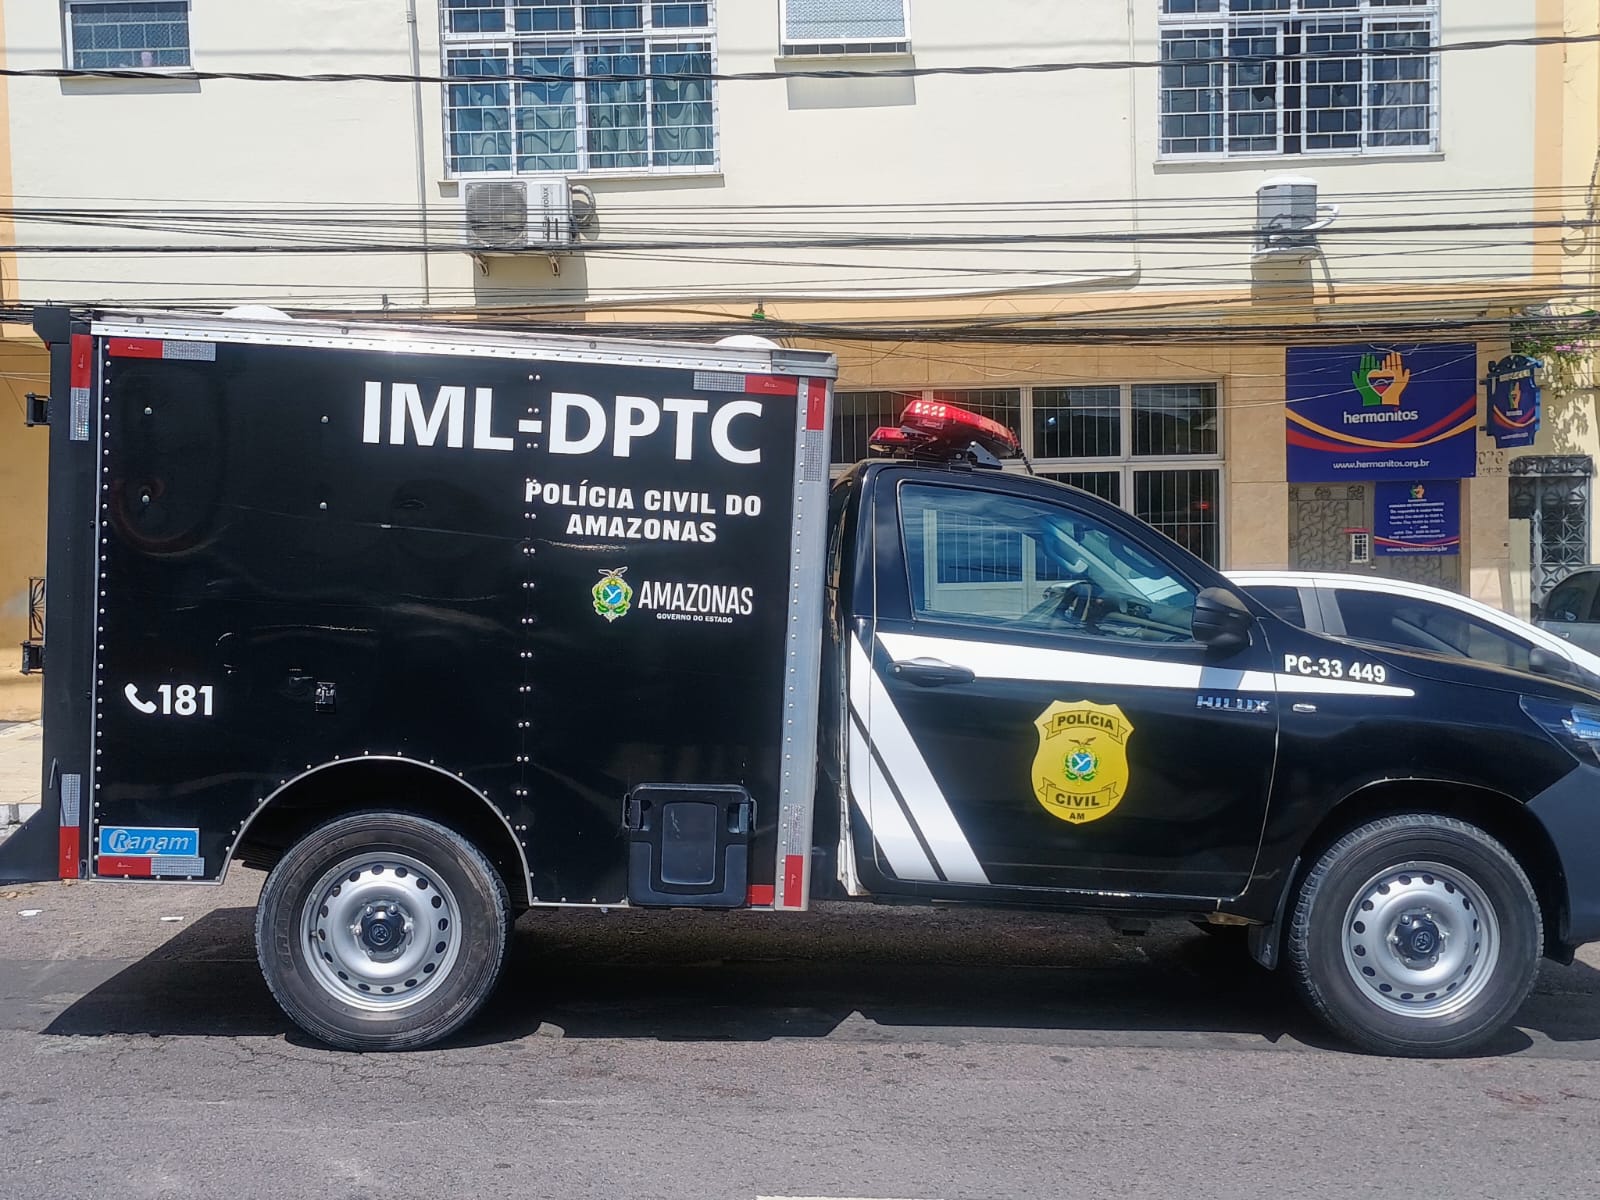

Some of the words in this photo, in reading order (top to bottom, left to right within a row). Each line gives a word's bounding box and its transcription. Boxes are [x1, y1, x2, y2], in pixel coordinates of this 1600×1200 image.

[363, 381, 763, 464] IML-DPTC
[1343, 408, 1419, 424] hermanitos
[1333, 458, 1430, 470] www.hermanitos.org.br
[525, 479, 634, 509] POLÍCIA
[644, 489, 716, 514] CIVIL
[725, 494, 761, 516] DO
[566, 513, 717, 543] AMAZONAS
[638, 581, 754, 615] AMAZONAS
[656, 612, 692, 621] GOVERNO
[693, 614, 703, 622] DO
[705, 615, 733, 624] ESTADO
[1284, 654, 1343, 678] PC-33
[1349, 662, 1386, 683] 449
[157, 684, 213, 716] 181
[1196, 695, 1270, 713] HILUX
[1057, 712, 1114, 730] POLÍCIA
[1055, 793, 1100, 807] CIVIL
[109, 829, 189, 852] Ranam
